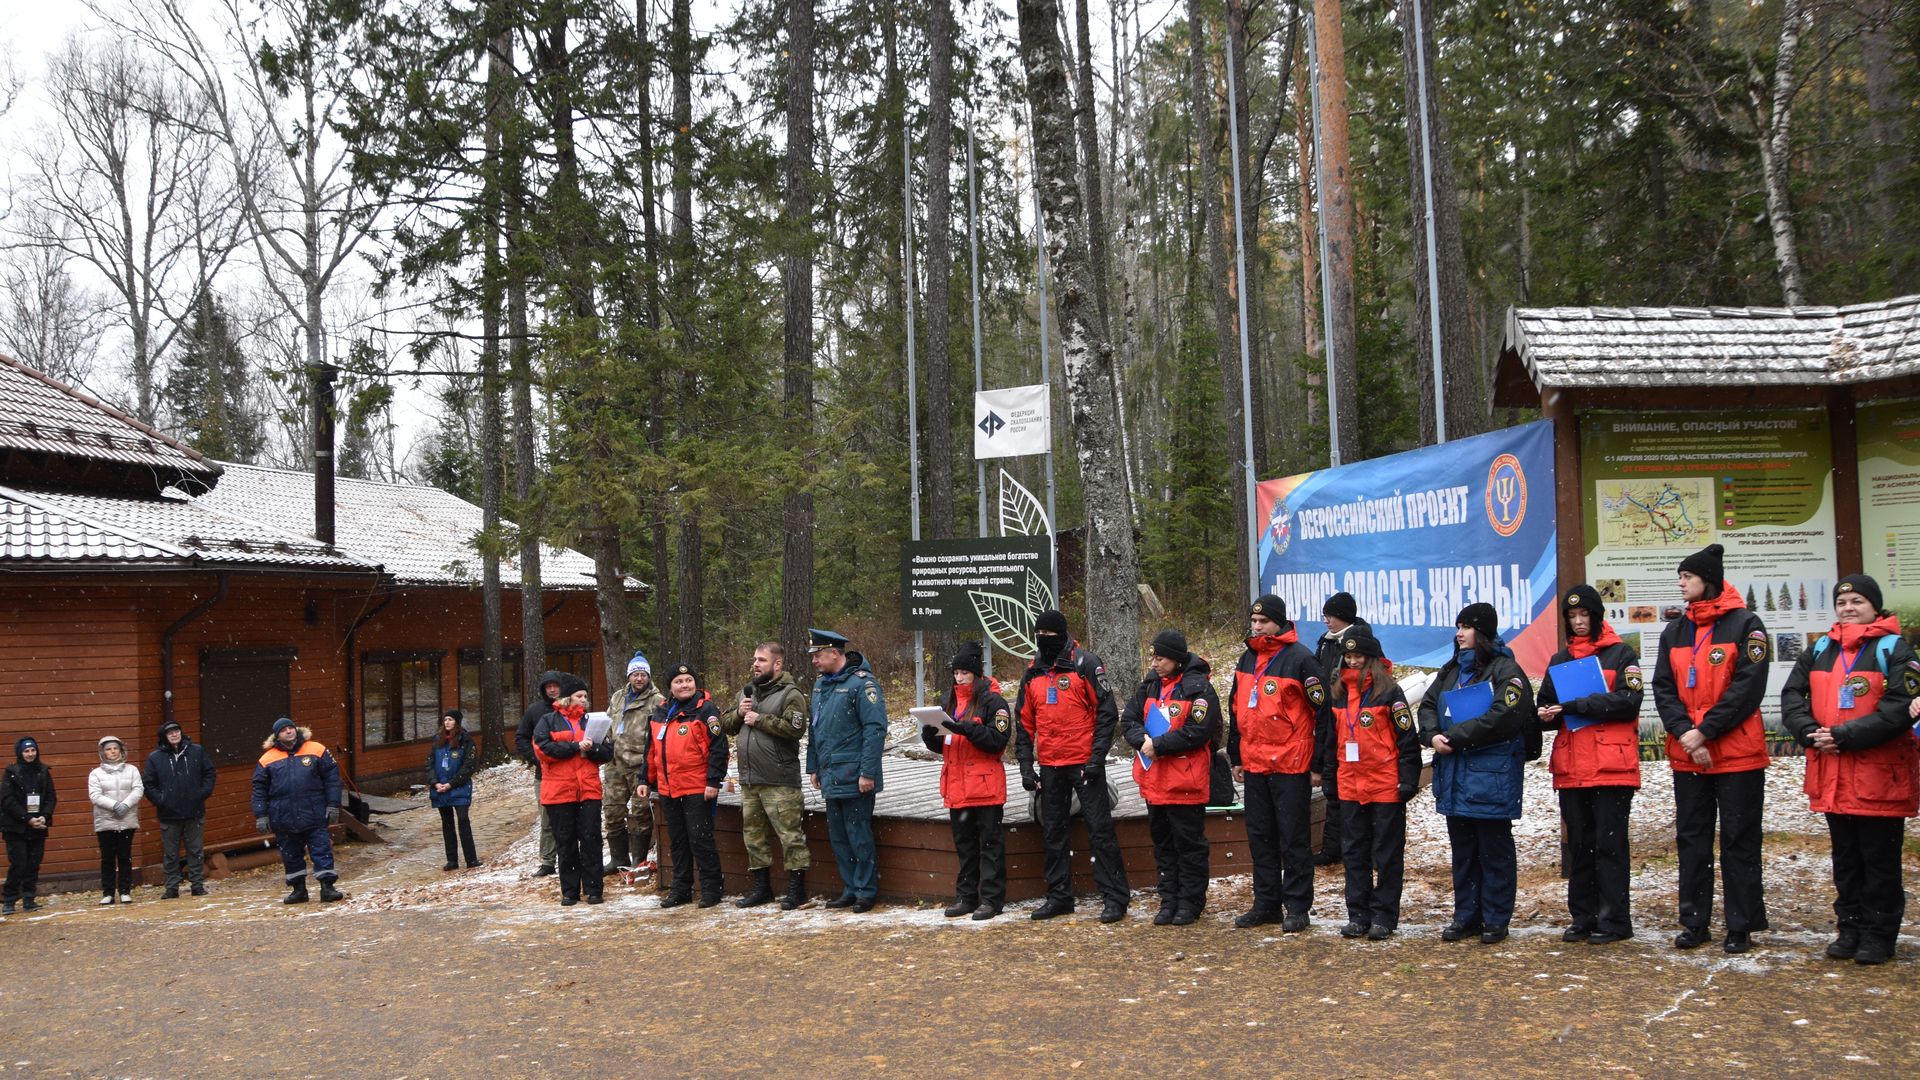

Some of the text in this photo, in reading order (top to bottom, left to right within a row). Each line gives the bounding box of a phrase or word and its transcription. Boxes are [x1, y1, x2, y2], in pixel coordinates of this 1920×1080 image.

[1010, 409, 1035, 418] ФЕДЕРАЦИЯ
[1612, 419, 1798, 433] ВНИМАНИЕ, ОПАСНЫЙ УЧАСТОК!
[1660, 454, 1679, 462] ГОДА
[1710, 452, 1770, 460] ТУРИСТИЧЕСКОГО
[1298, 488, 1405, 540] ВСЕРОССИЙСКИЙ
[1405, 485, 1469, 529] ПРОЕКТ
[912, 551, 1039, 564] «Важно сохранить уникальное богатство
[911, 565, 1025, 576] природных ресурсов, растительного
[951, 578, 967, 587] мира
[968, 576, 989, 585] нашей
[989, 577, 1015, 586] страны,
[925, 608, 942, 616] Путин
